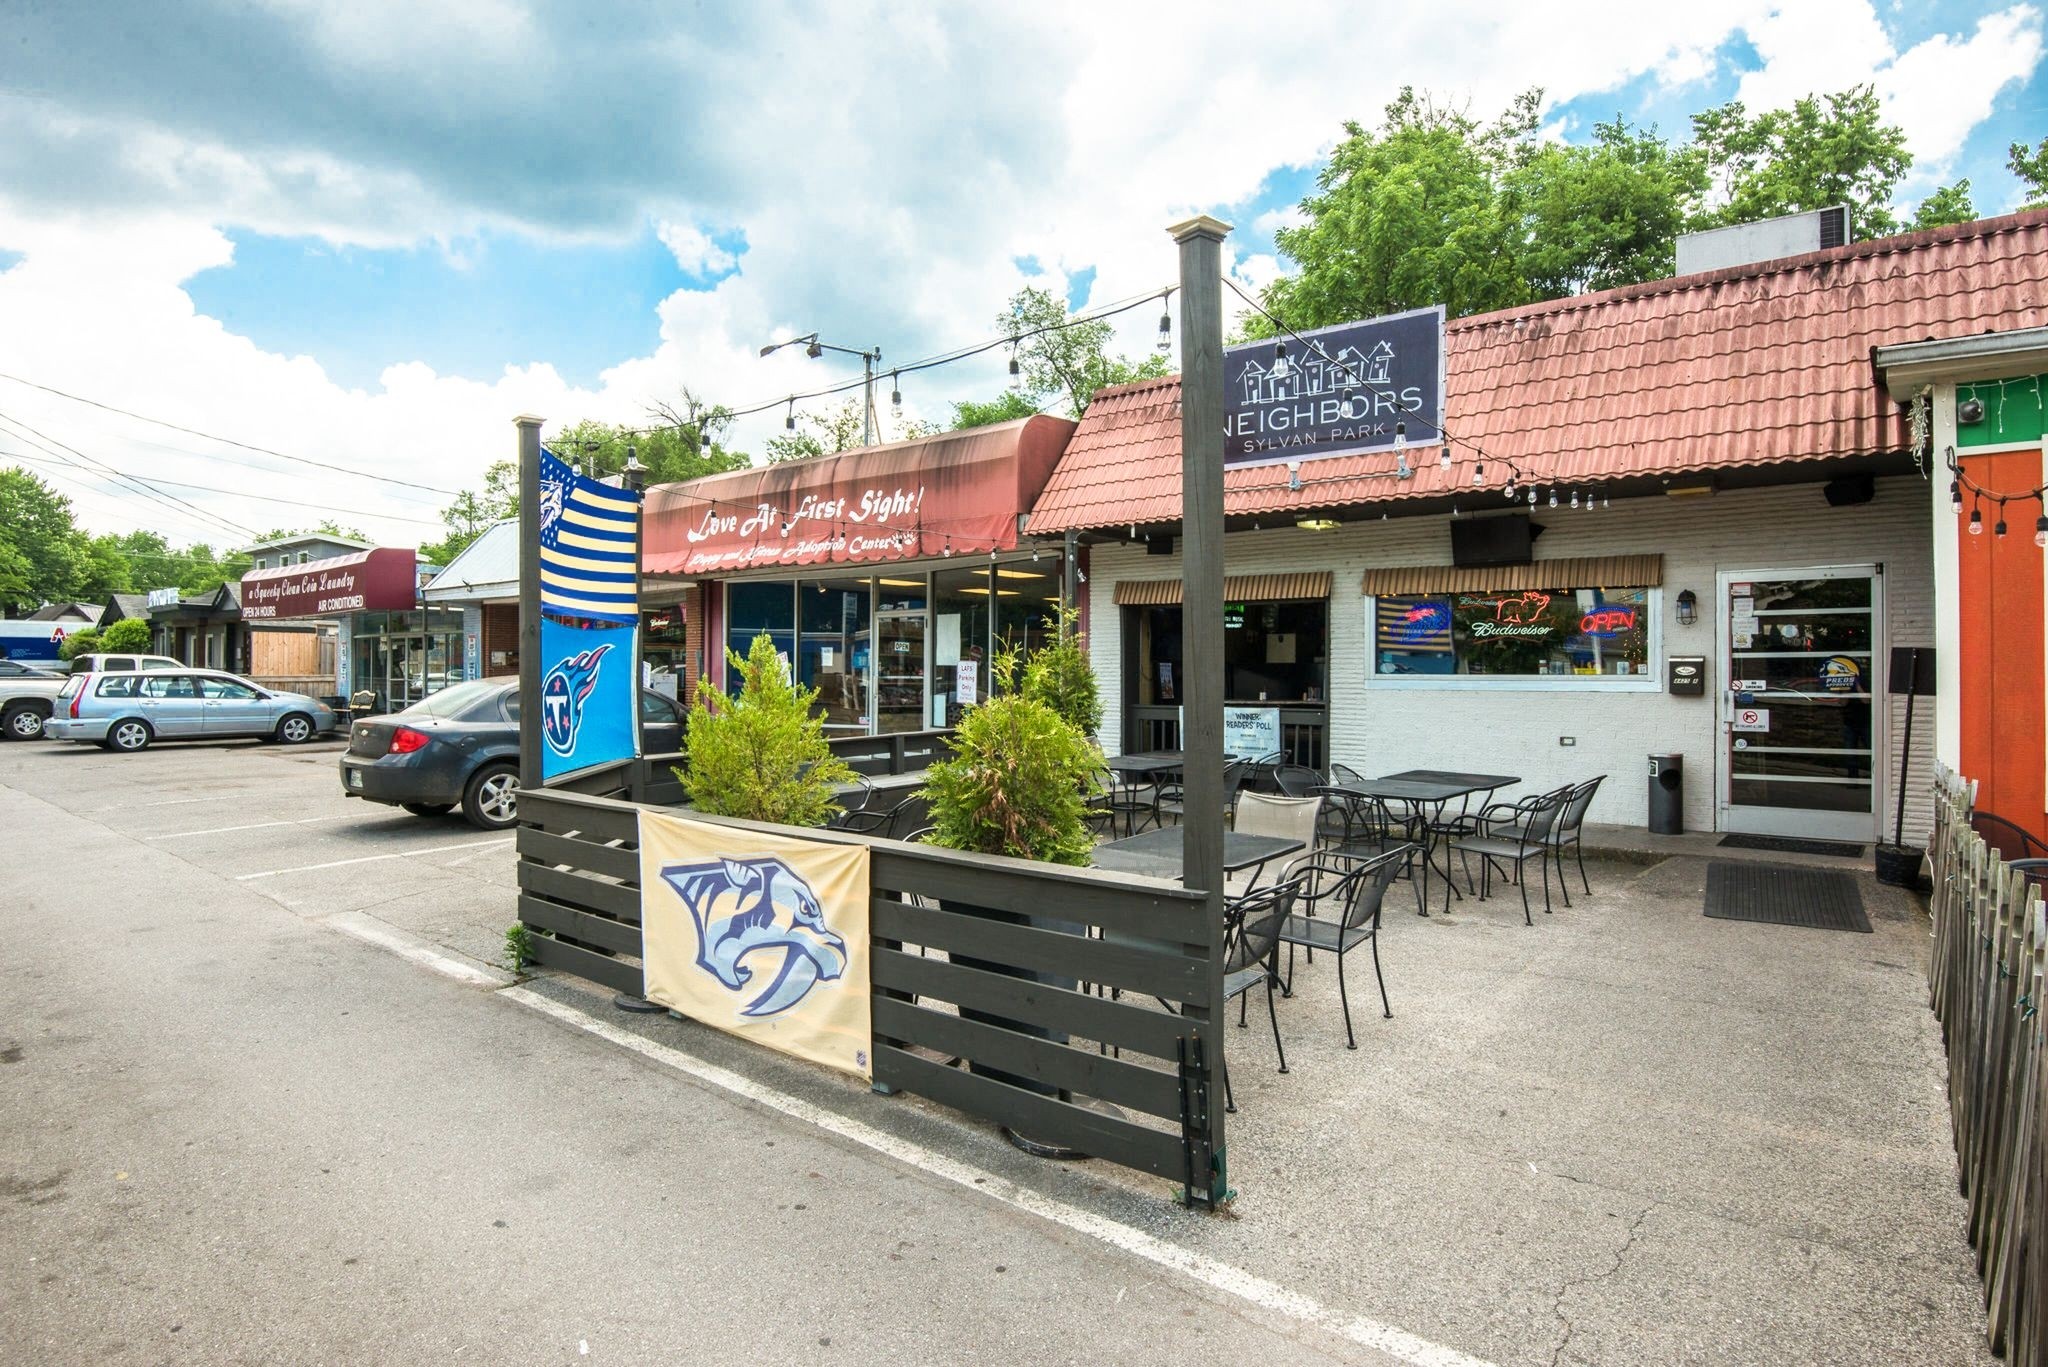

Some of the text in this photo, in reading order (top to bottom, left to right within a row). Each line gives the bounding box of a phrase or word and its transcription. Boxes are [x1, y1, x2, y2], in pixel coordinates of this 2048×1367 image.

[1223, 386, 1423, 437] NEIGHBORS
[1243, 422, 1386, 453] SYLVAN PARK
[687, 486, 925, 543] Love At First Sight!
[721, 548, 744, 561] and
[782, 537, 847, 559] Adoption
[848, 535, 892, 555] Center
[281, 579, 301, 597] Clean
[301, 575, 317, 594] Coin
[318, 571, 355, 592] Laundry
[242, 605, 277, 618] OPEN 24 HOURS
[317, 594, 364, 612] AIR CONDITIONED
[1471, 622, 1555, 637] Budweiser
[1580, 611, 1636, 633] OPEN
[895, 642, 909, 651] OPEN
[958, 674, 975, 683] Parking
[961, 684, 972, 692] Only
[1226, 720, 1272, 731] READERS' POLL
